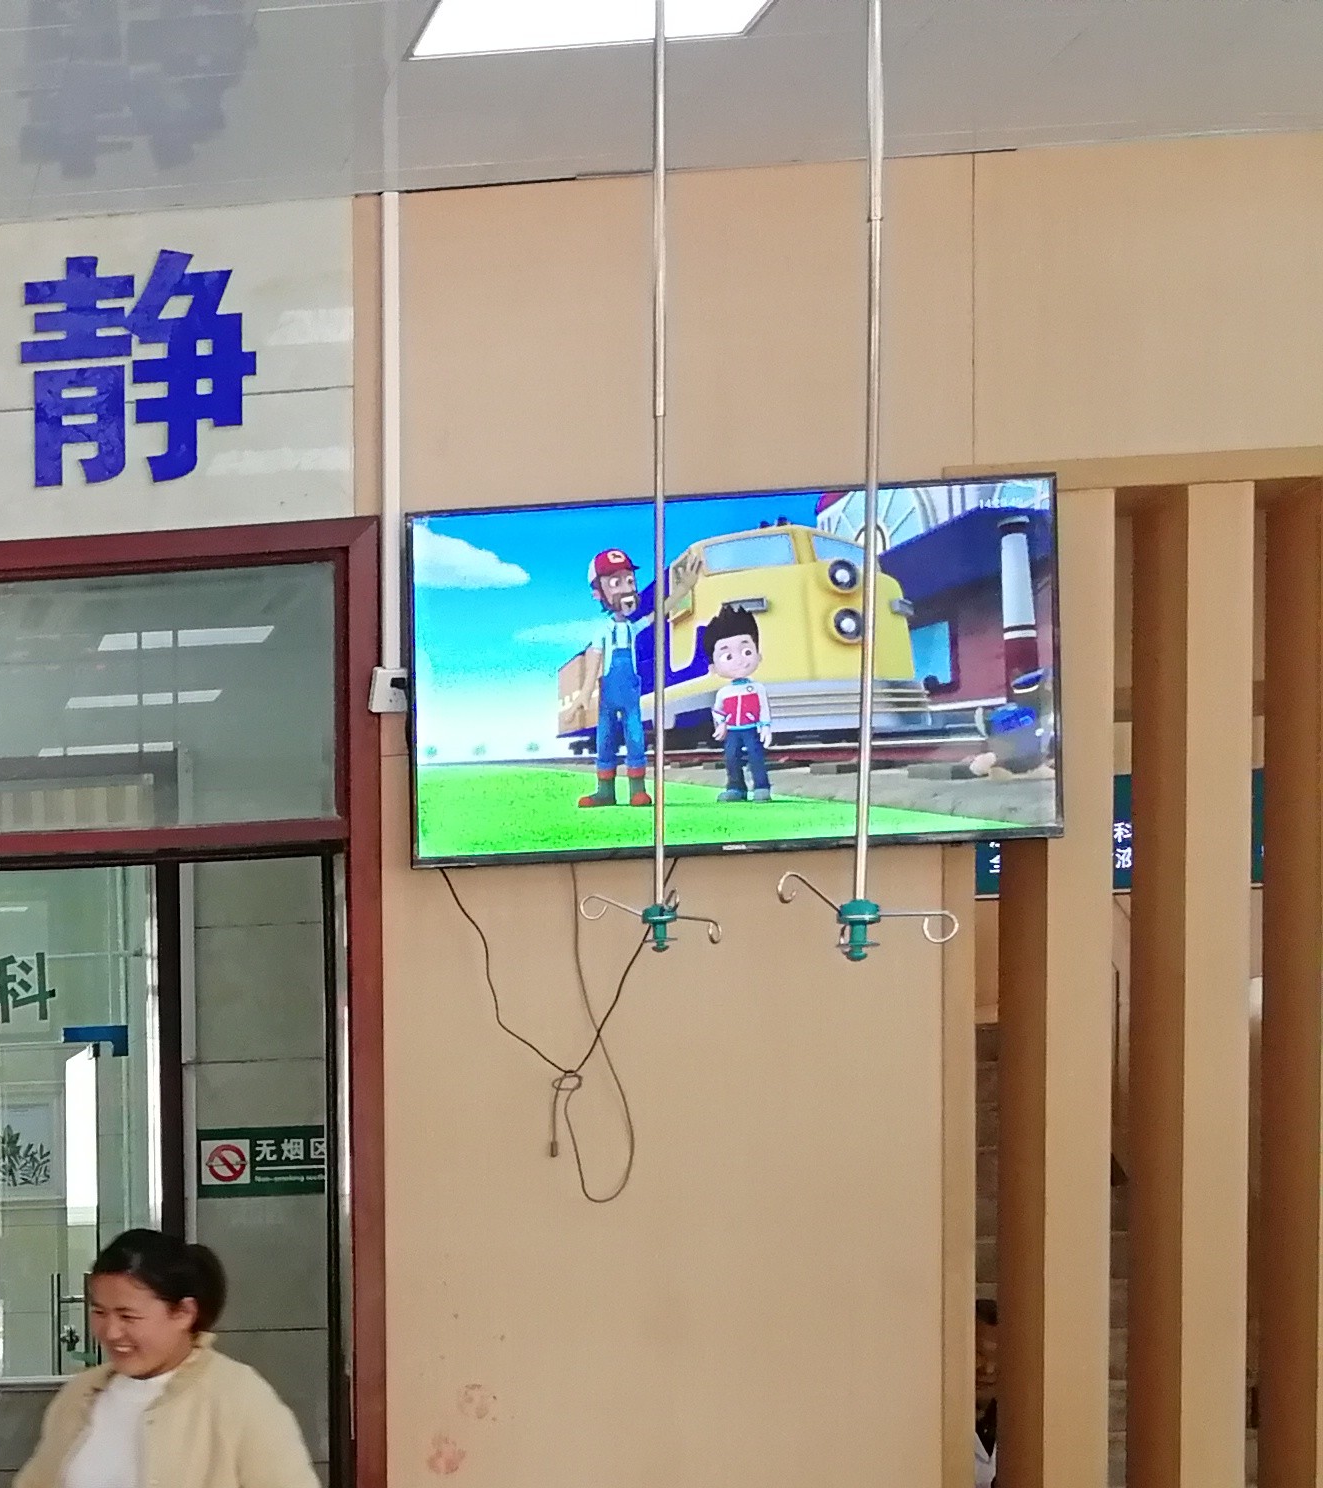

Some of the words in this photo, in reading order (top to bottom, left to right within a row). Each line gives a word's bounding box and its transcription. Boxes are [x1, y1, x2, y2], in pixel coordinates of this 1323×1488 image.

[20, 249, 257, 488] 静
[255, 1138, 326, 1161] 无烟区
